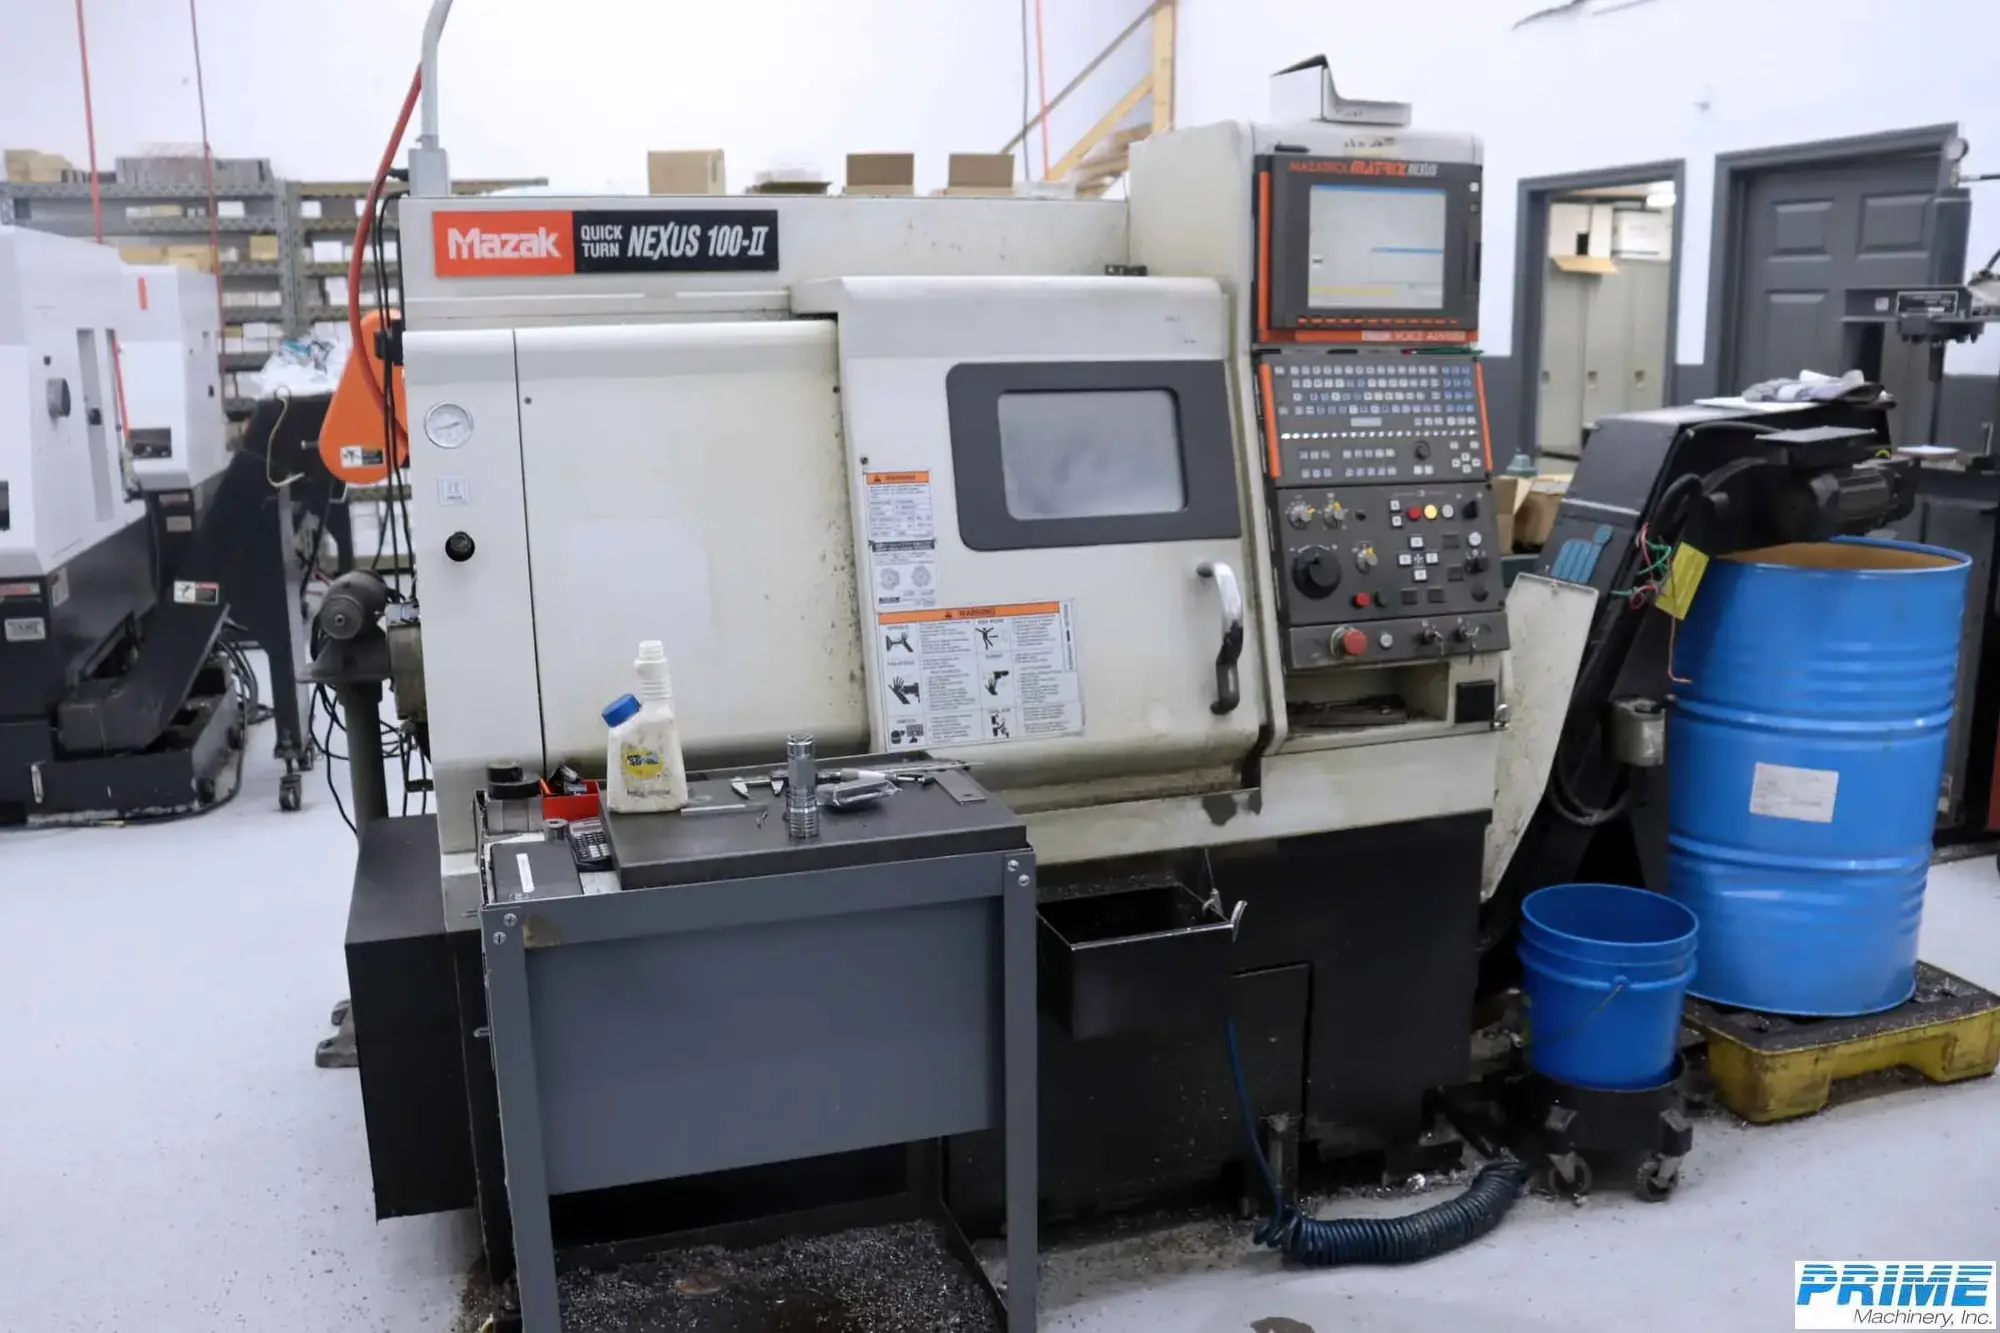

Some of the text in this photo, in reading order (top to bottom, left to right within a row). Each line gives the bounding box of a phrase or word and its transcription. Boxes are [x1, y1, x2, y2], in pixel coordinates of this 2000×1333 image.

[447, 226, 562, 260] Mazak
[581, 224, 623, 240] QUICK
[627, 221, 701, 260] NEXUS
[581, 242, 620, 258] TURN
